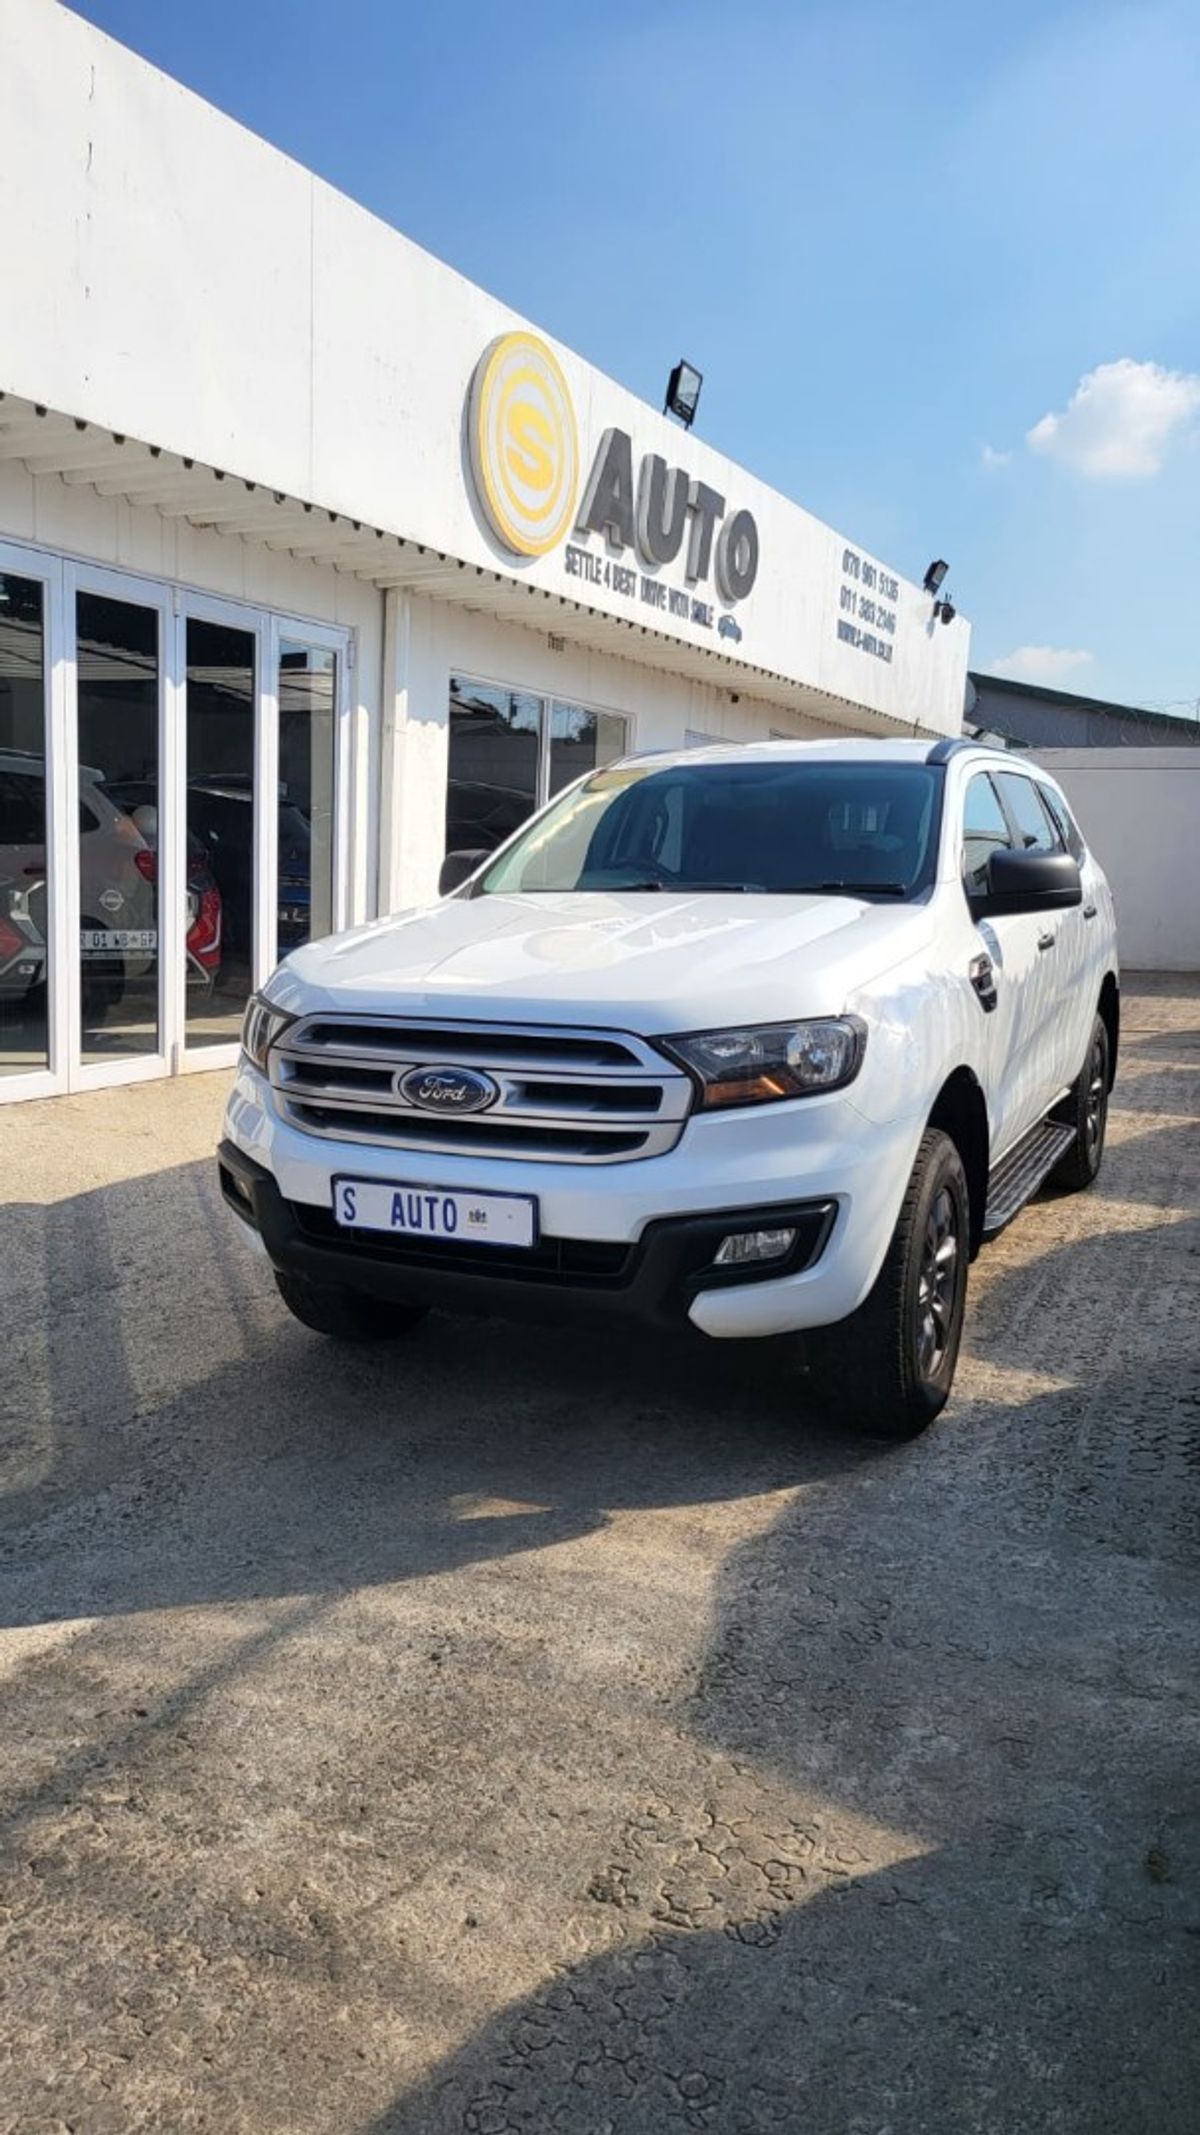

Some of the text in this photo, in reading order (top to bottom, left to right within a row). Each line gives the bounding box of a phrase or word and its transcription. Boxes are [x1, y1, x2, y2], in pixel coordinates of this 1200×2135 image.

[507, 402, 758, 601] S AUTO
[565, 544, 602, 586] SETTLE
[604, 561, 610, 589] 4
[613, 563, 637, 598] BEST
[640, 575, 667, 610] DRIVE
[840, 585, 857, 614] 011
[419, 1076, 467, 1101] Ford
[343, 1187, 458, 1233] S AUTO
